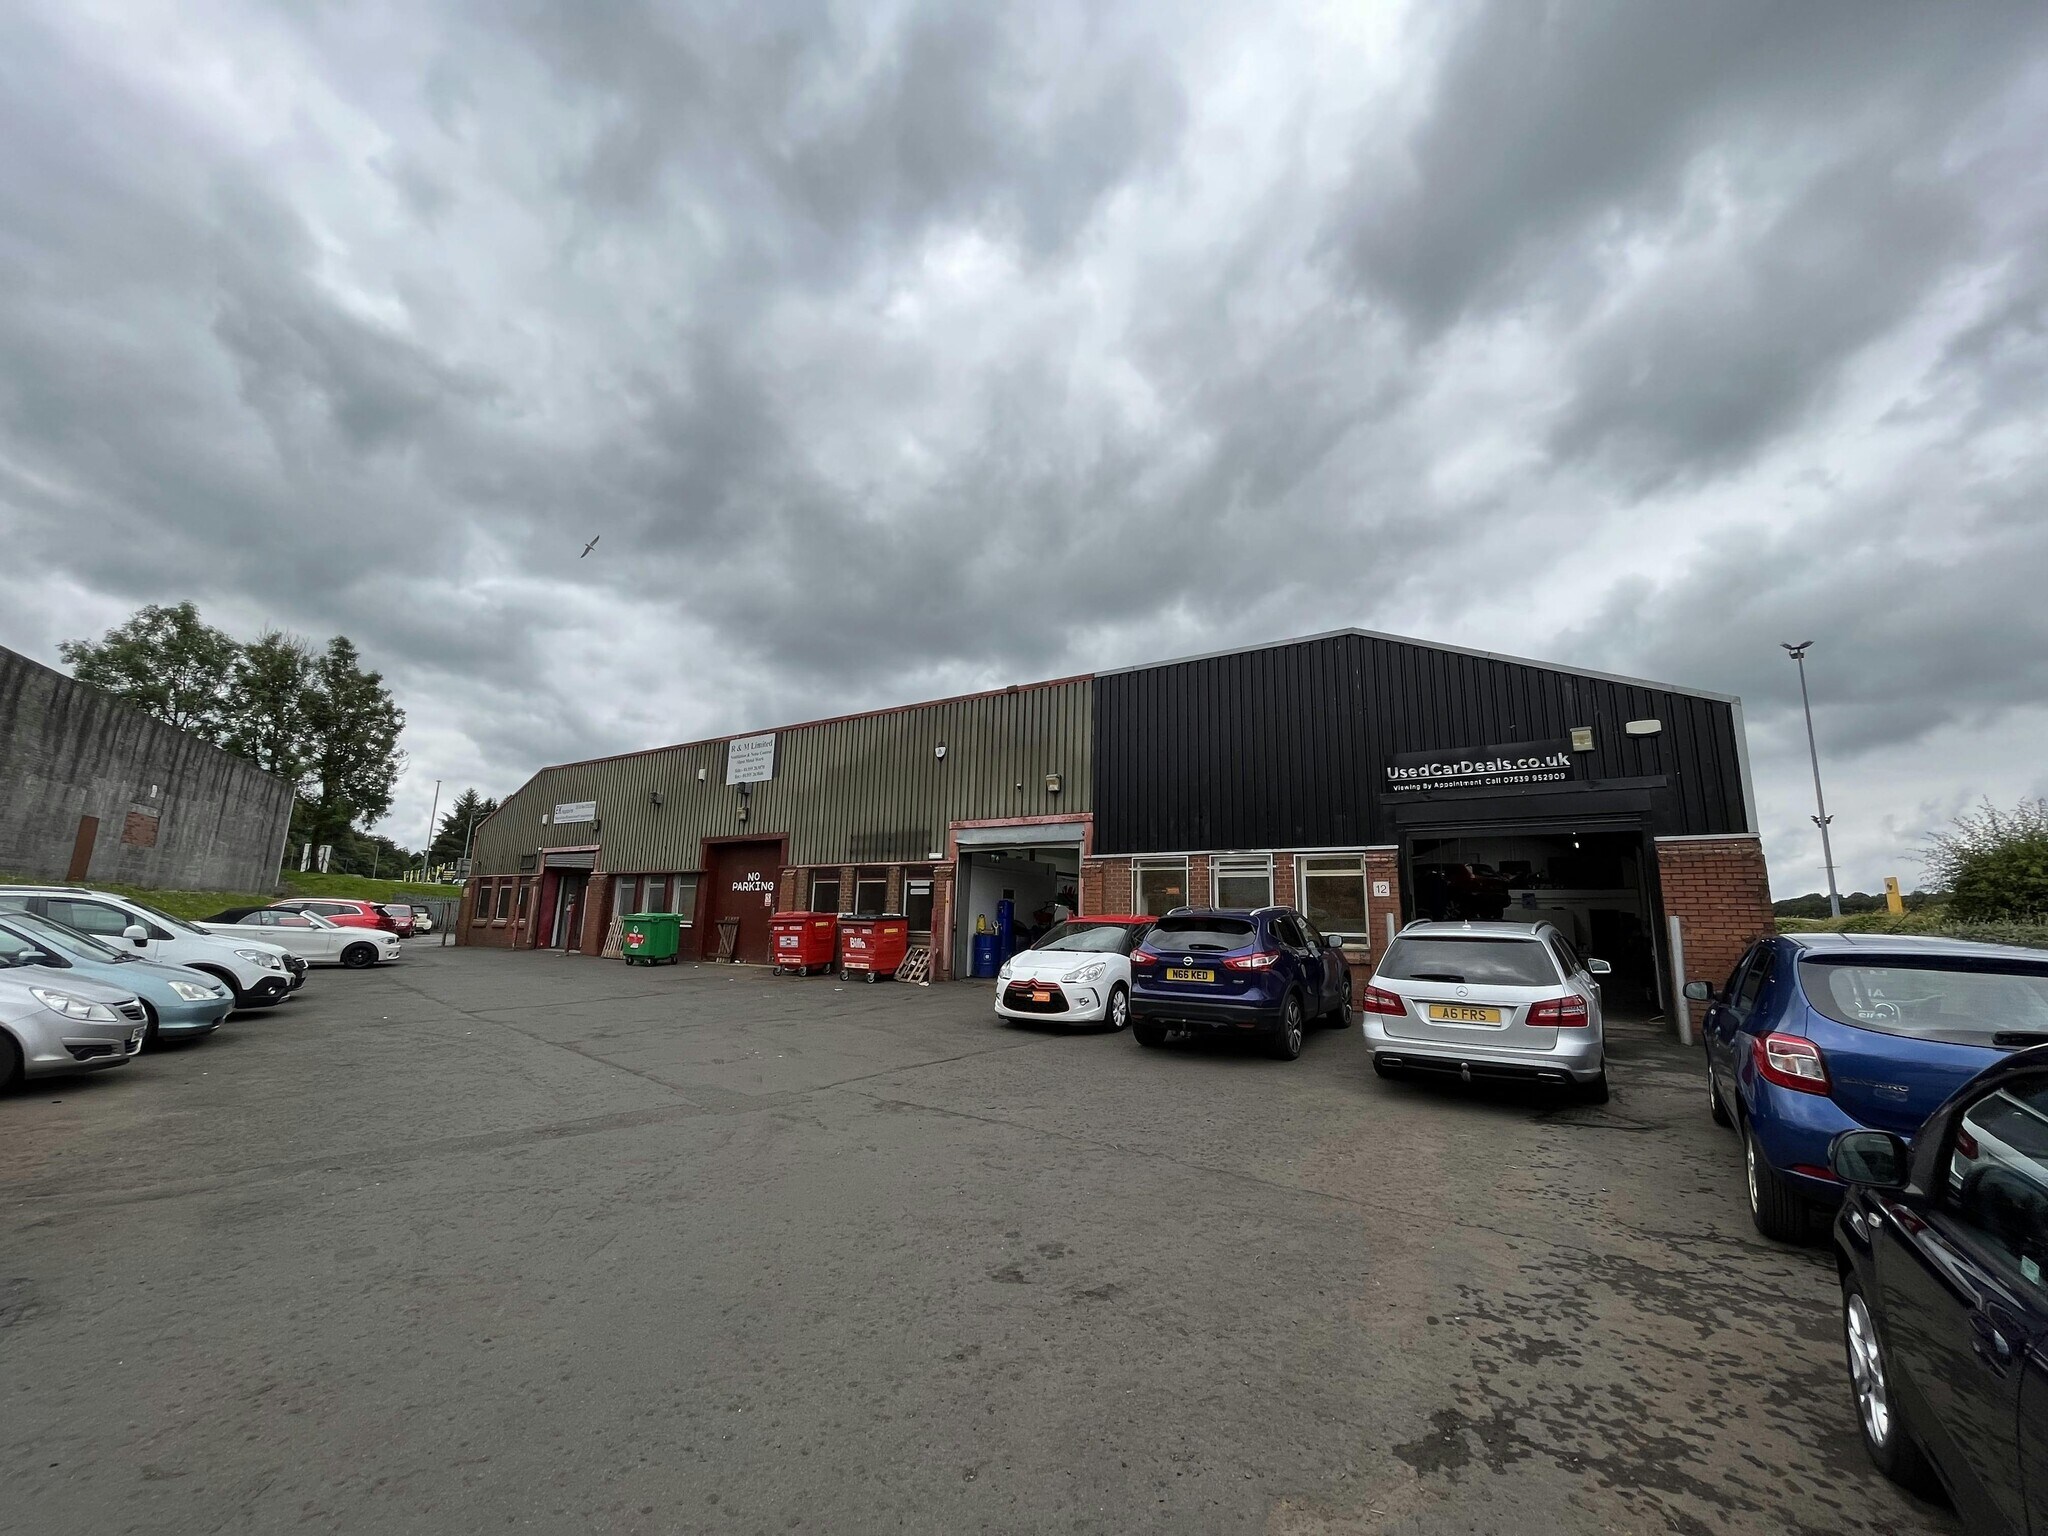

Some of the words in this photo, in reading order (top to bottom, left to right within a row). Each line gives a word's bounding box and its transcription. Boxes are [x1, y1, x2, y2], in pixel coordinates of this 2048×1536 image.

[751, 740, 773, 750] Limited
[1386, 752, 1570, 778] UsedCarDeals.co.uk
[1392, 783, 1421, 792] Viewing
[1422, 782, 1432, 790] By
[1433, 779, 1482, 789] Appointment
[1485, 776, 1501, 785] Call
[1503, 774, 1530, 784] 07539
[1531, 772, 1566, 782] 952909
[747, 871, 761, 881] NO
[732, 881, 775, 892] PARKING
[1375, 884, 1388, 894] 12
[1172, 969, 1190, 979] N66
[1190, 970, 1208, 980] KED
[1442, 1008, 1459, 1019] A6
[1460, 1009, 1487, 1021] FRS
